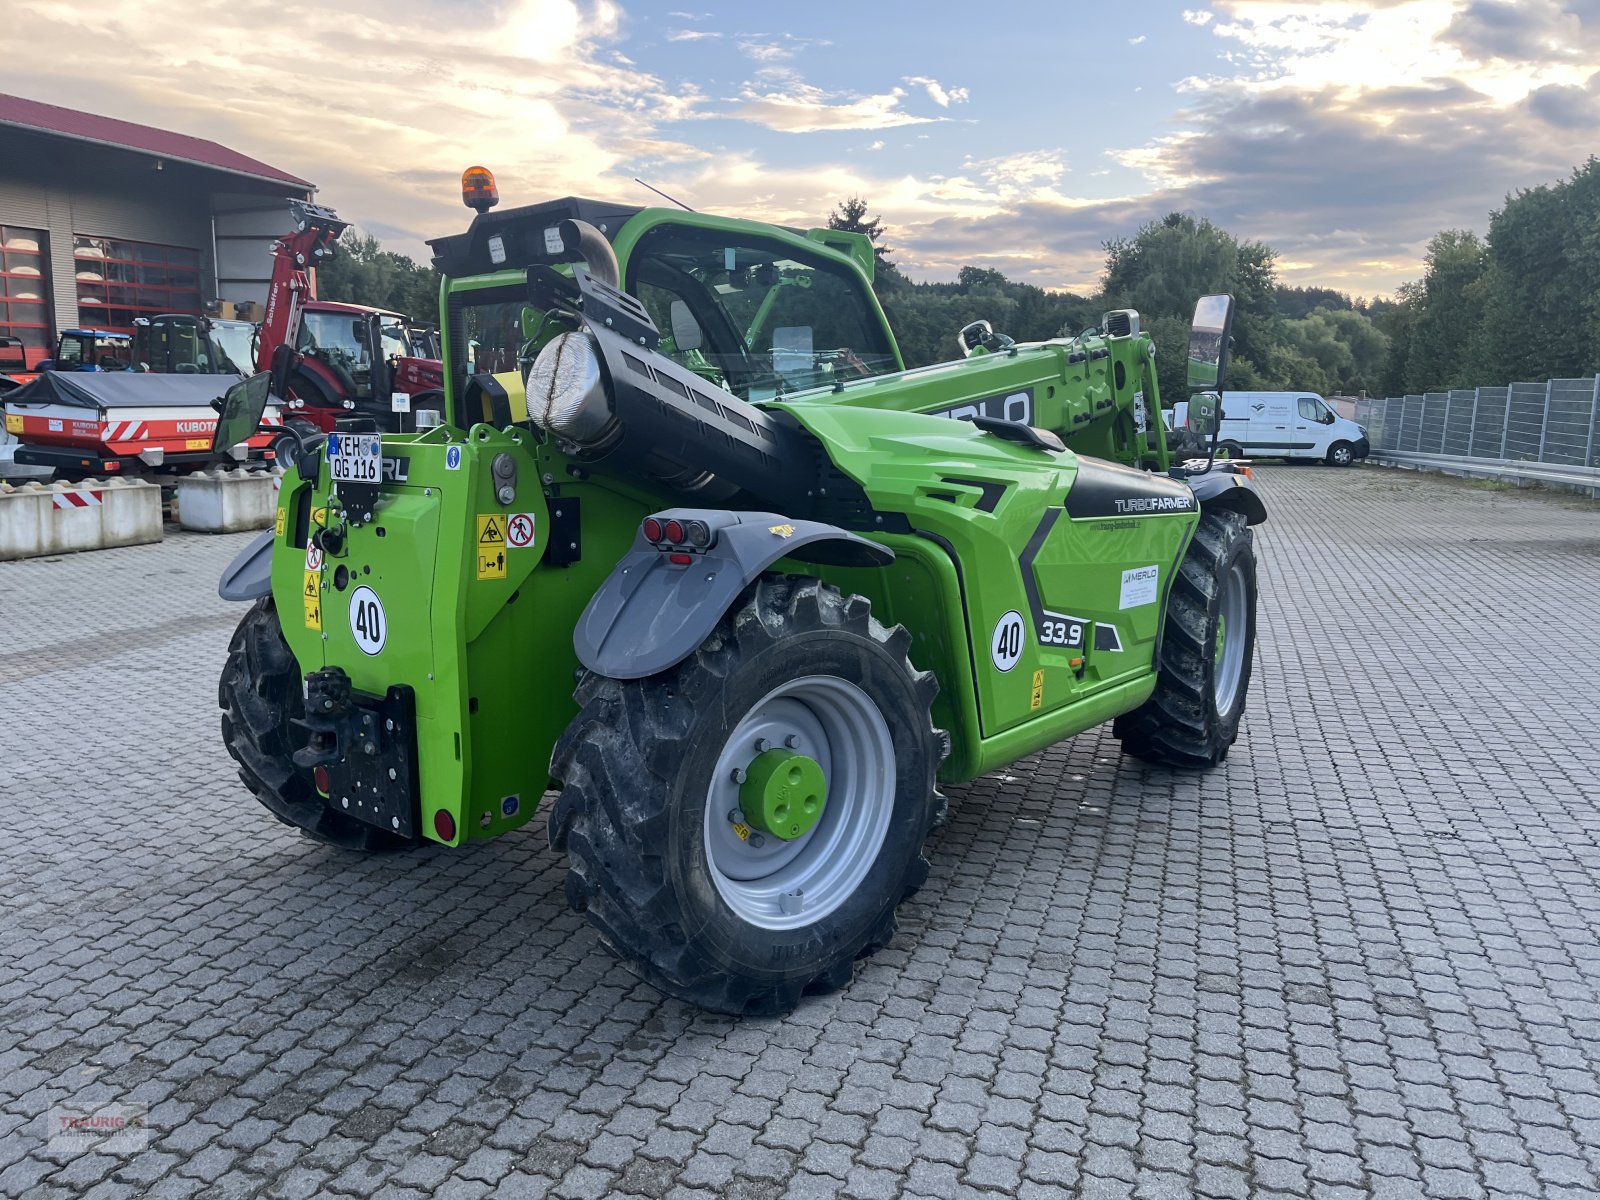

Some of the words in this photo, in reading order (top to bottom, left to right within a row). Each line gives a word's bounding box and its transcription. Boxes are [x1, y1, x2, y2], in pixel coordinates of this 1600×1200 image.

[266, 282, 279, 327] Schäffer
[72, 421, 98, 430] KUBOTA
[337, 436, 361, 457] KEH
[334, 458, 350, 478] QG
[353, 459, 376, 480] 116
[1114, 497, 1191, 513] TURBOFARMER
[1131, 569, 1157, 582] MERLO
[356, 600, 380, 643] 40
[997, 622, 1020, 660] 40
[1040, 621, 1082, 646] 33.9
